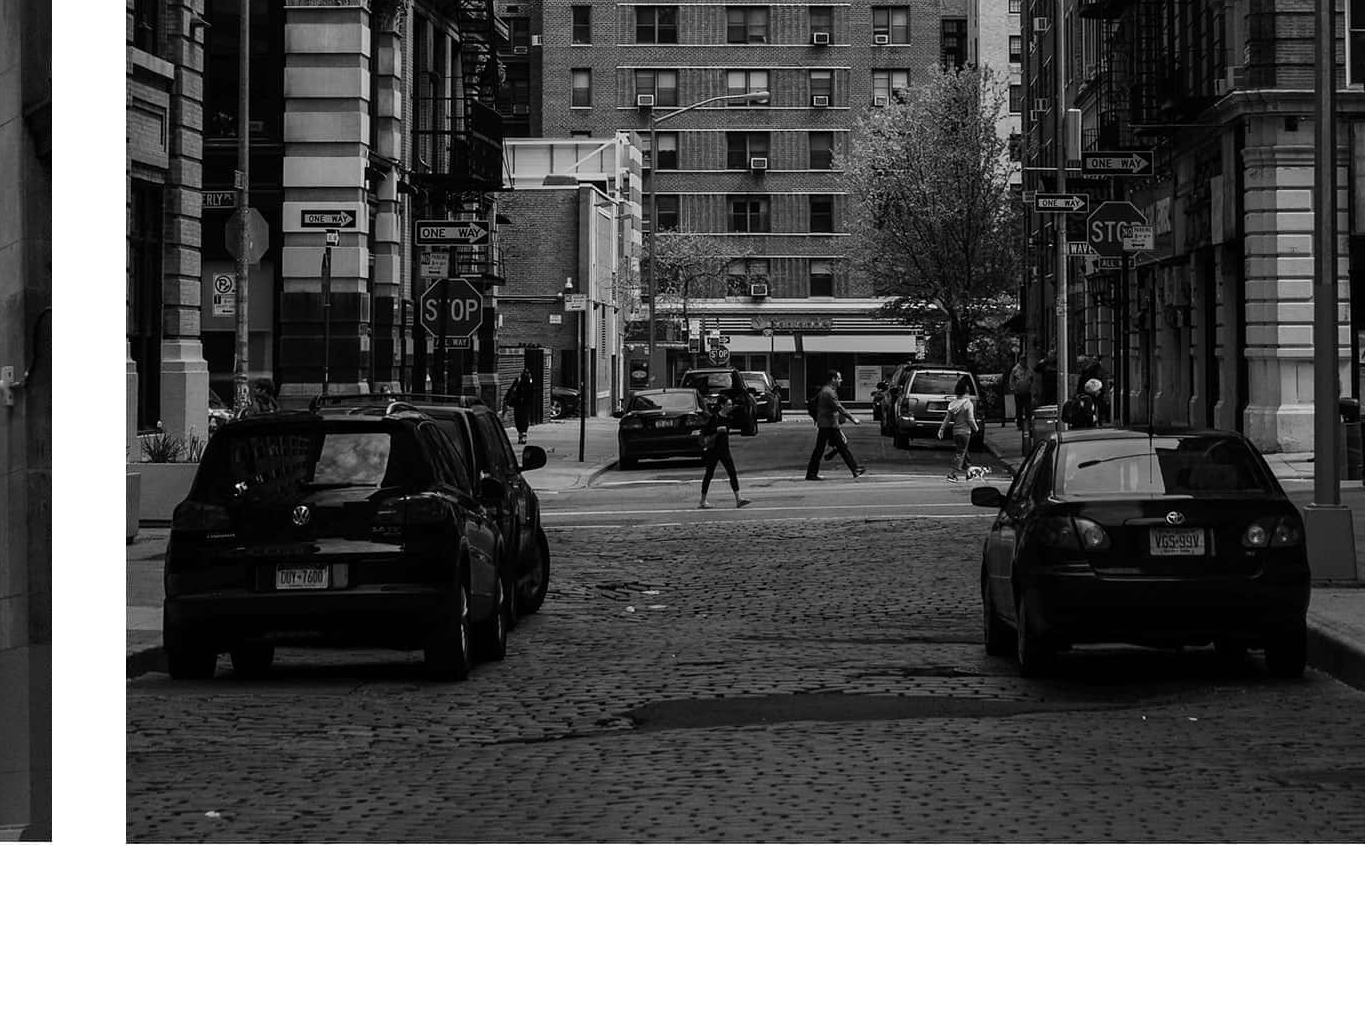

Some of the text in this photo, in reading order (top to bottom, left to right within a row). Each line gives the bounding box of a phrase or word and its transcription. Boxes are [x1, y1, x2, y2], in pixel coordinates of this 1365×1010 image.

[1092, 159, 1141, 168] ONE WAY
[1043, 198, 1080, 206] ONE WAY
[309, 215, 348, 223] ONE WAY
[422, 228, 480, 238] ONE WAY
[425, 298, 479, 322] SOP
